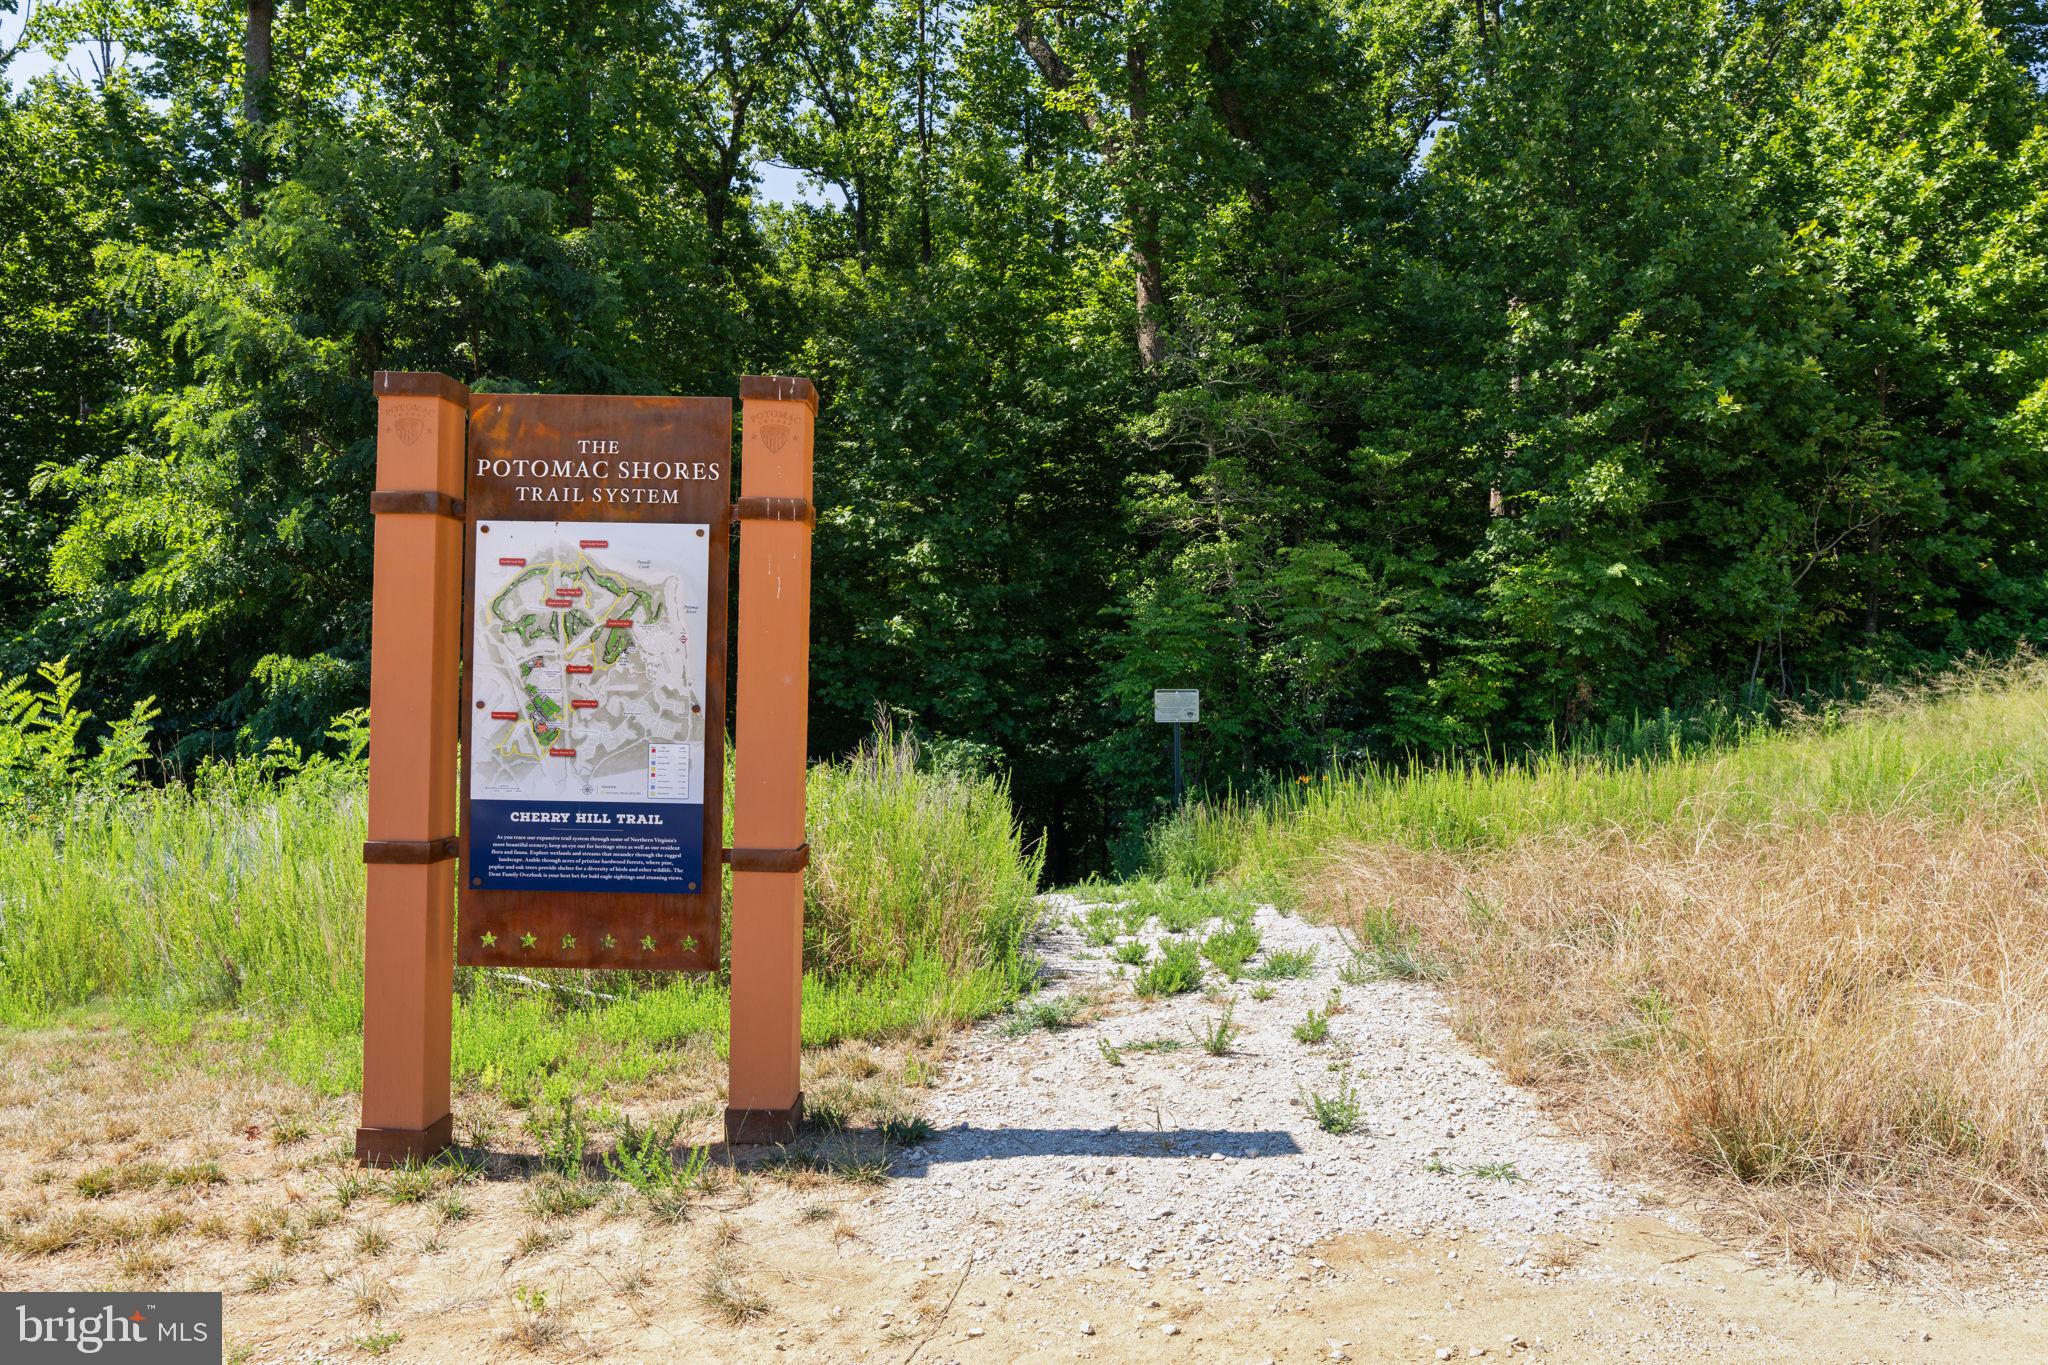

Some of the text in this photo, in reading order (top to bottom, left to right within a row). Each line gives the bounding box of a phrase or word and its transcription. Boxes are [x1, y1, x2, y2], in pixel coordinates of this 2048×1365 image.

[385, 403, 436, 417] POTOMAC
[751, 410, 801, 424] POTOMAC
[578, 440, 619, 454] THE
[476, 458, 721, 481] POTOMAC SHORES
[515, 486, 680, 505] TRAIL SYSTEM
[510, 811, 663, 825] CHERRY HILL TRAIL
